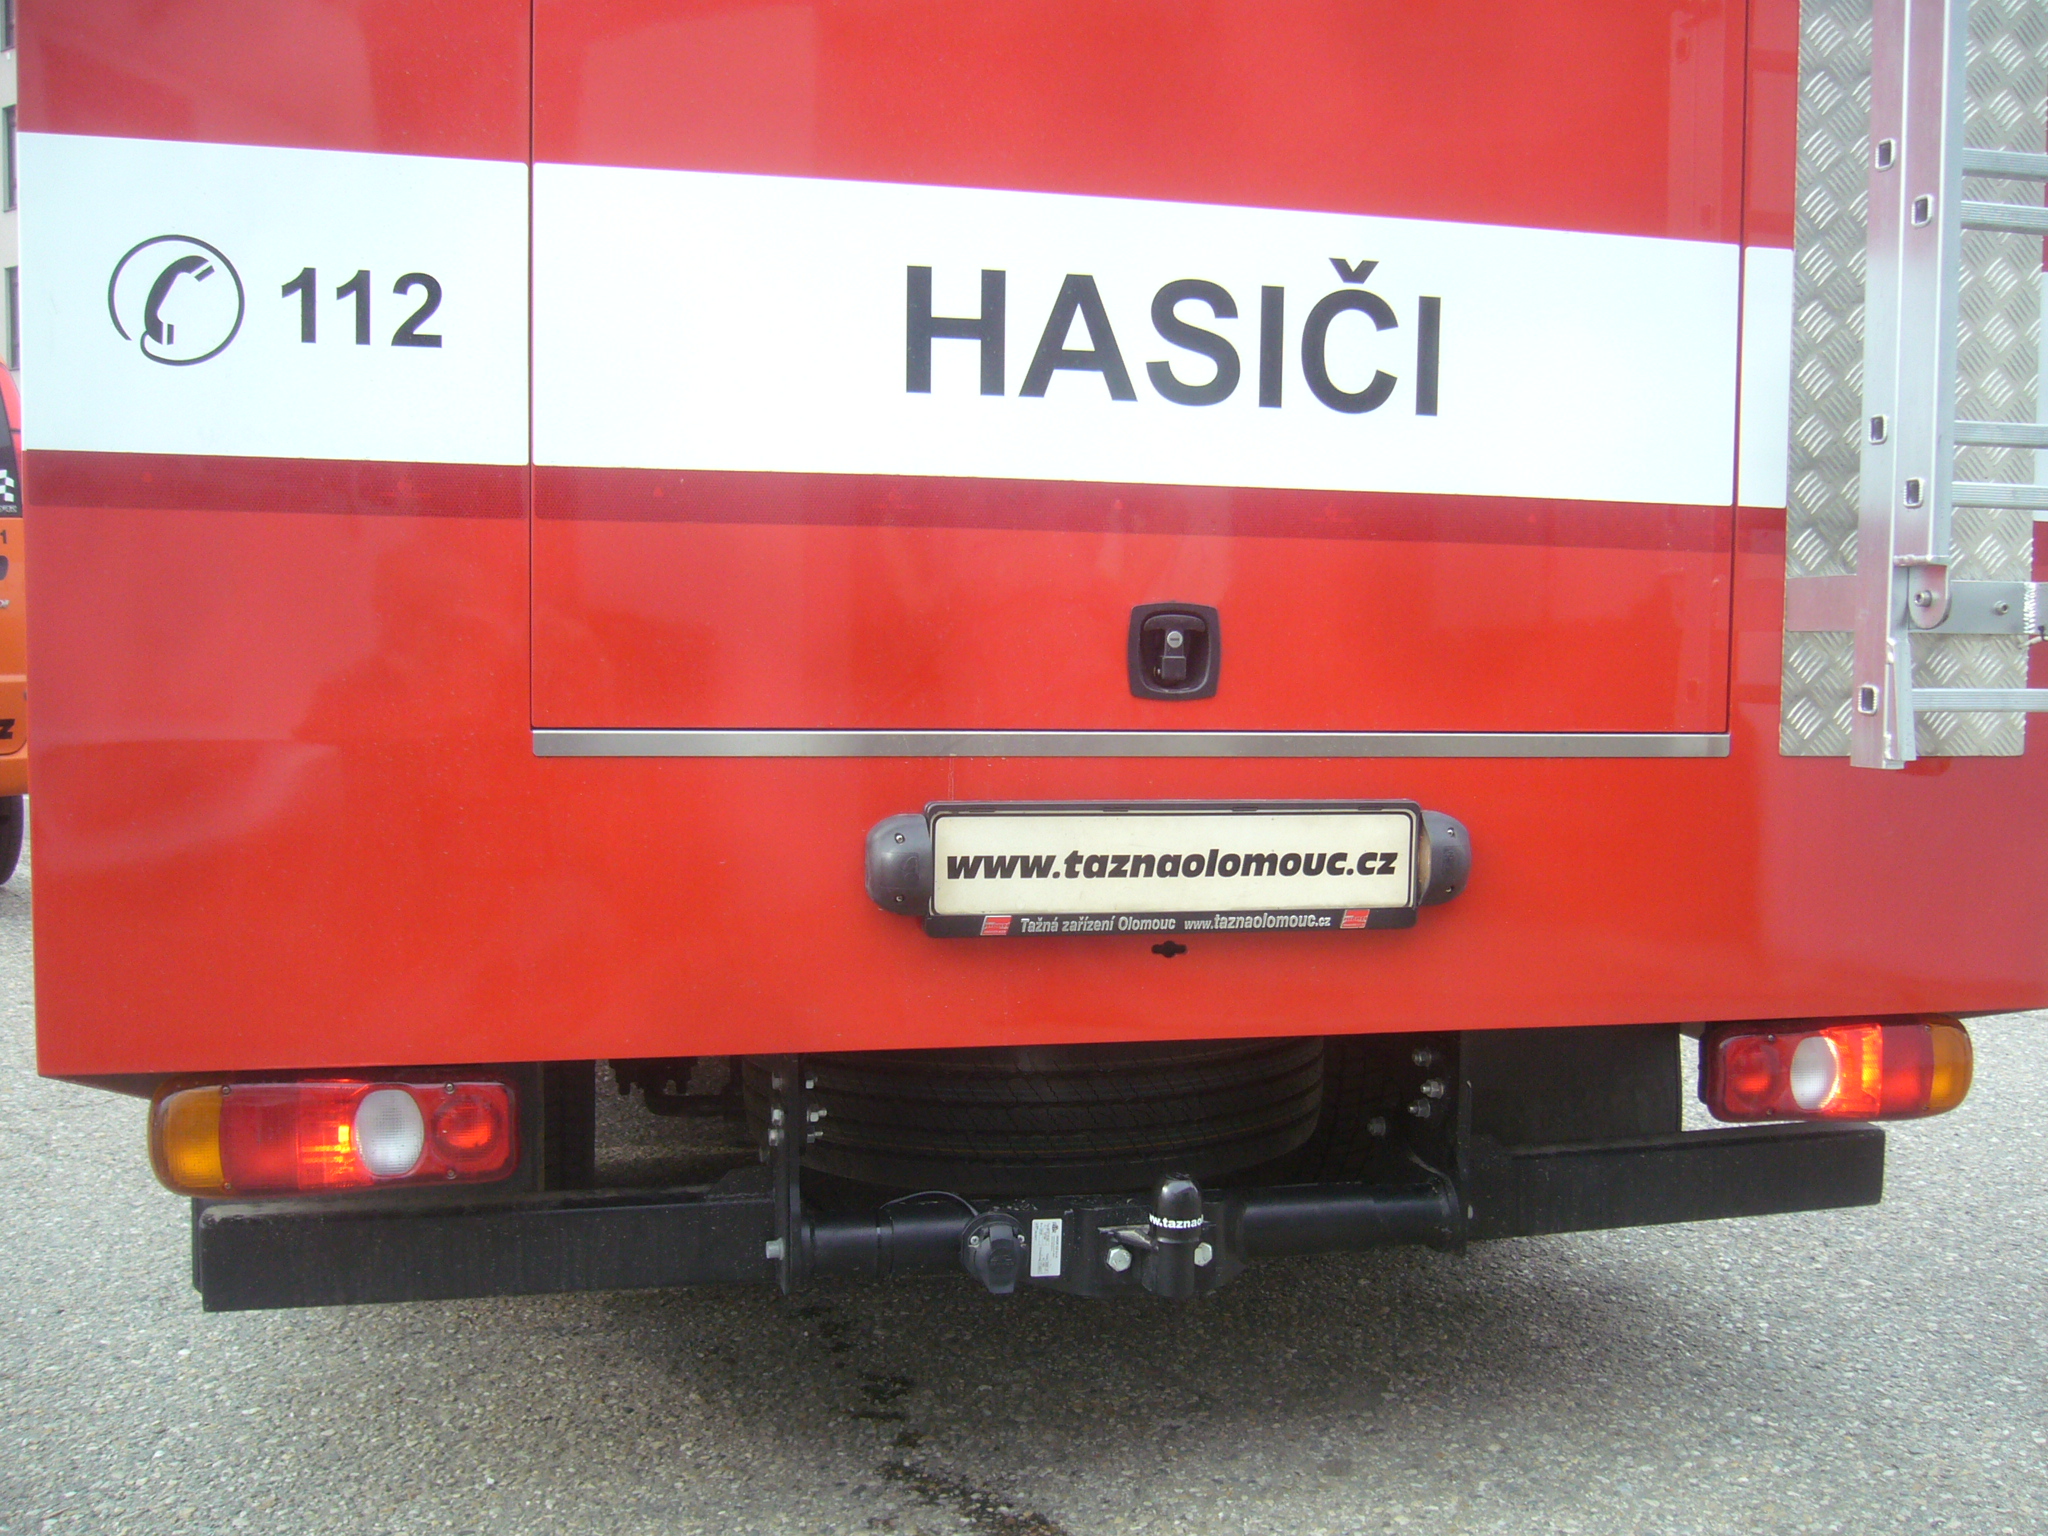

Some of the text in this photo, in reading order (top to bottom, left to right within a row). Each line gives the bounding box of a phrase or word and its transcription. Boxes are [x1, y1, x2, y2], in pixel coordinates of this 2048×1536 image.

[281, 266, 443, 349] 112
[905, 257, 1442, 417] HASIČI
[946, 848, 1398, 880] www.taznaolomouc.cz
[1020, 917, 1059, 933] Tažná
[1062, 915, 1116, 932] zařízení
[1118, 915, 1176, 931] Olomouc
[1183, 912, 1332, 930] www.taznaolomouc.cz
